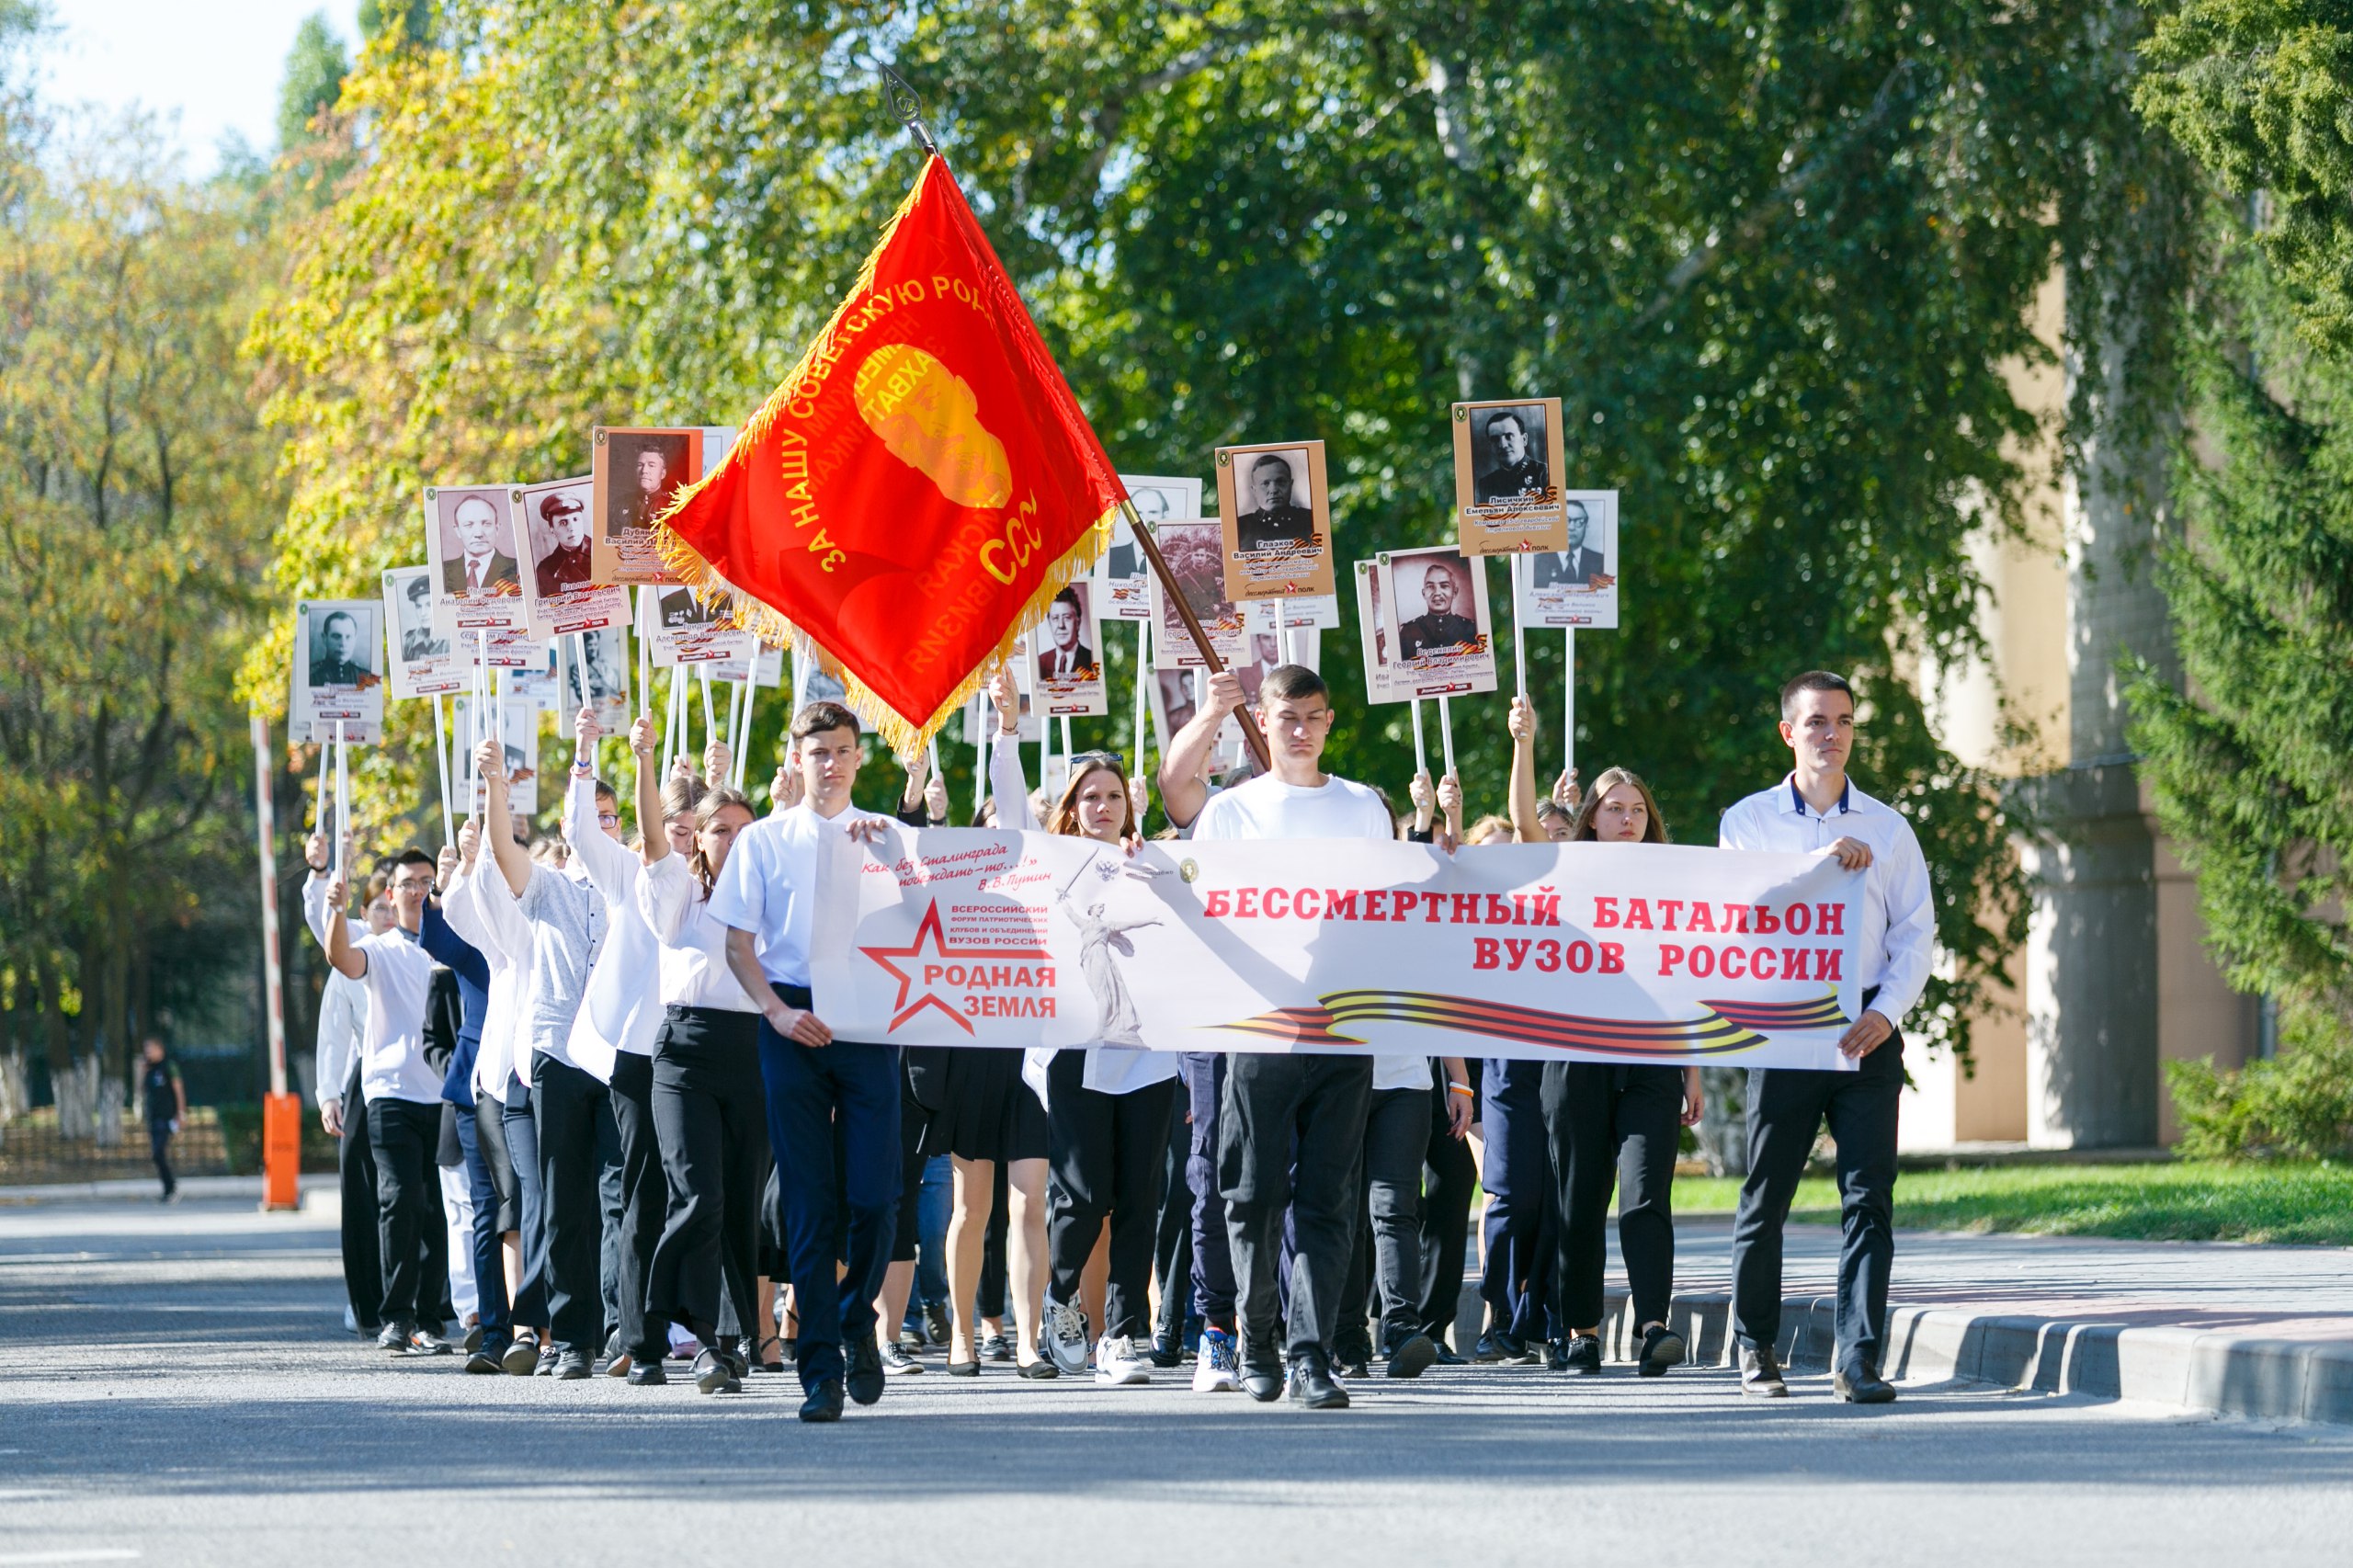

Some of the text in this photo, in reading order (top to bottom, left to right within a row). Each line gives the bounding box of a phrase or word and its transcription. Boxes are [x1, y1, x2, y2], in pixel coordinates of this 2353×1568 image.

[789, 278, 926, 418] СОВЕТСКУЮ
[781, 428, 820, 528] НАШУ
[1466, 506, 1505, 515] Емельян
[1490, 496, 1534, 505] Лисичкин
[979, 489, 1042, 585] ССС
[808, 528, 847, 574] ЗА
[1233, 548, 1322, 559] Василий Андреевич
[535, 587, 620, 607] Григорий Васильевич
[561, 582, 590, 591] Павлов
[440, 597, 480, 606] Анатолий
[1392, 659, 1426, 669] Георгий
[861, 843, 1008, 876] Как без Сталинграда
[951, 904, 1048, 914] ВСЕРОССИЙСКИЙ
[1203, 886, 1846, 937] БЕССМЕРТНЫЙ БАТАЛЬОН
[1472, 937, 1844, 982] ВУЗОВ РОССИИ
[924, 964, 1056, 991] РОДНАЯ
[963, 994, 1056, 1018] ЗЕМЛЯ
